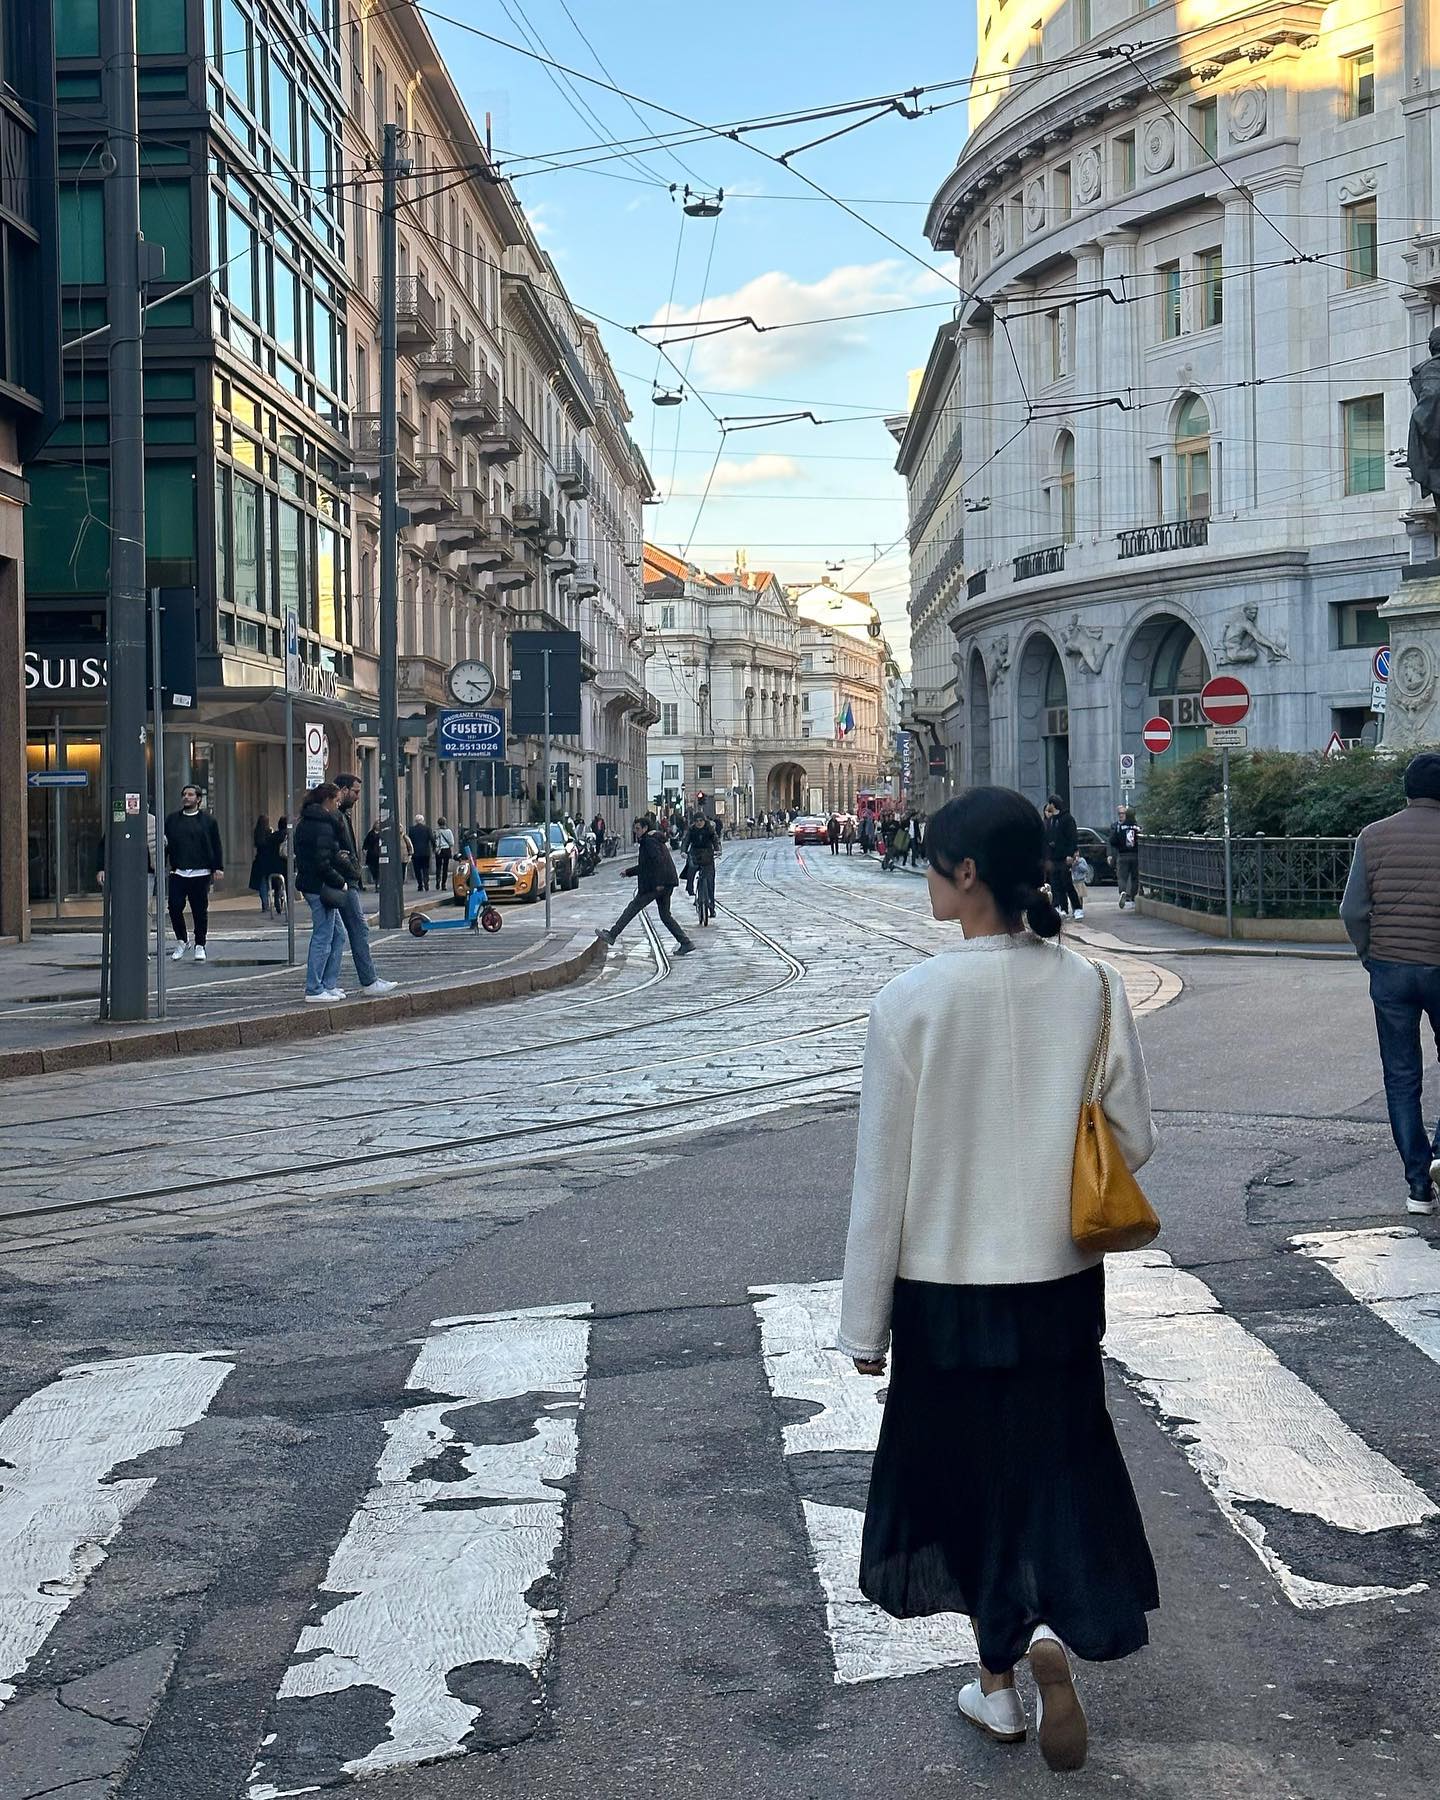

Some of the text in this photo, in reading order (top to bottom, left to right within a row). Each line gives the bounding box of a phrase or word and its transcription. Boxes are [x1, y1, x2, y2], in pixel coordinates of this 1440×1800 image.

[24, 651, 107, 689] SUIS
[451, 723, 493, 734] FUSETTI
[445, 743, 498, 751] 02.5513026
[903, 739, 911, 784] PANERAI
